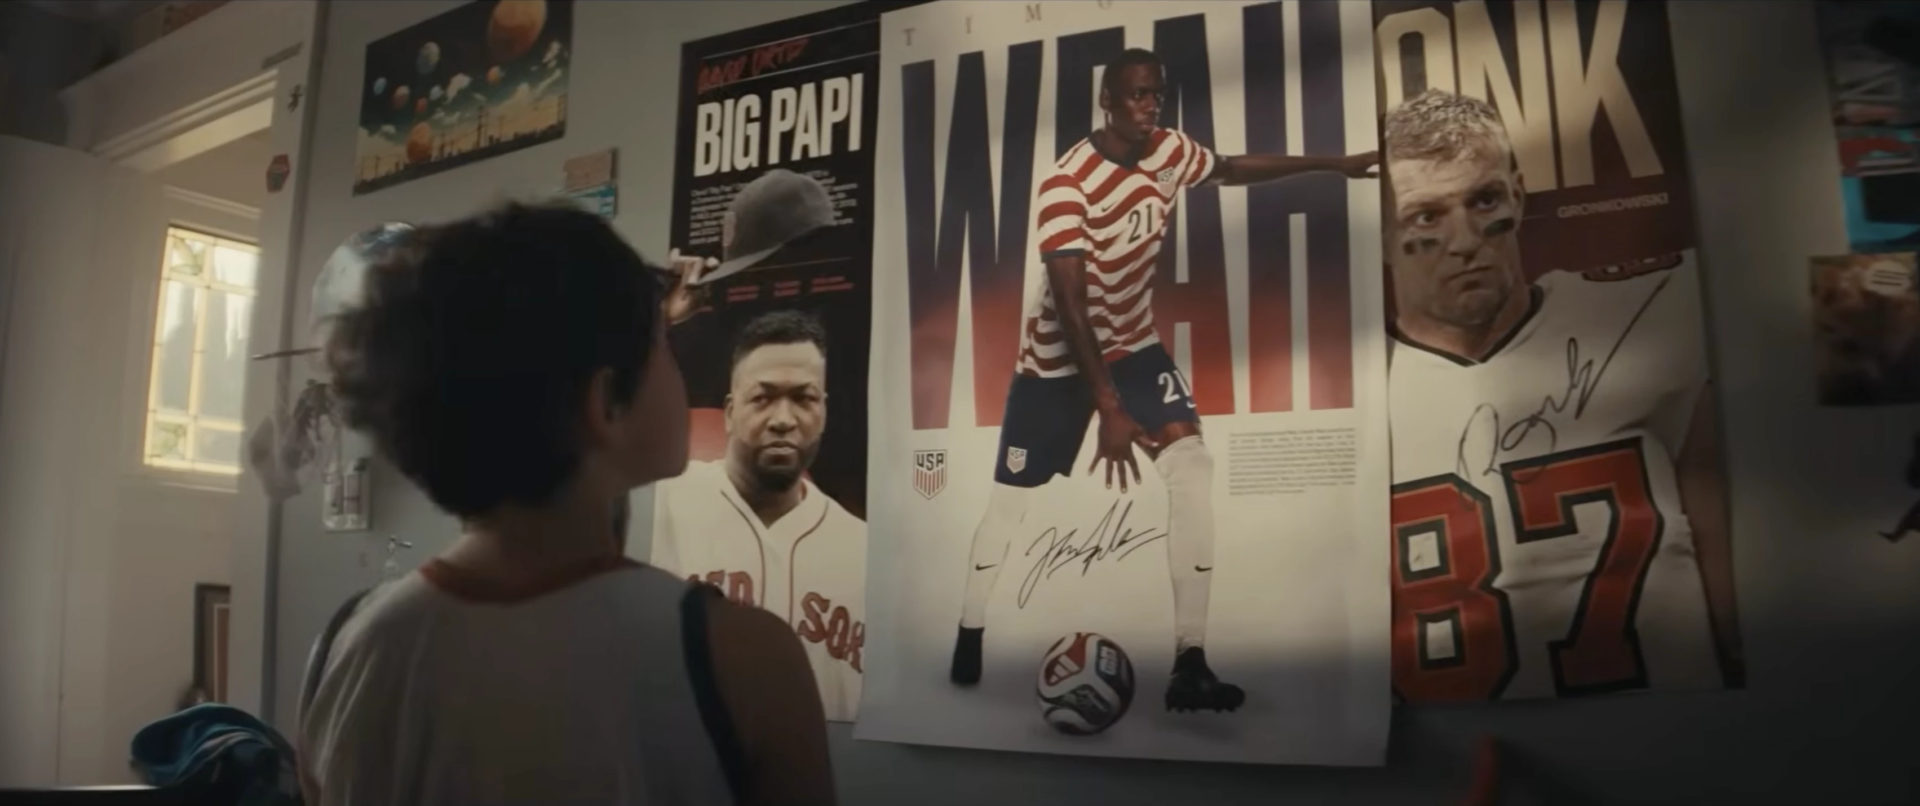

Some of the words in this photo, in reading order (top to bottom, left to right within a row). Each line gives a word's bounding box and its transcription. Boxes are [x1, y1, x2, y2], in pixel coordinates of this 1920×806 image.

[693, 94, 761, 177] BIG
[768, 73, 863, 165] PAPI
[1557, 191, 1669, 218] GRONKOWSKI
[1128, 203, 1153, 245] 21
[1158, 369, 1191, 404] 21
[916, 452, 945, 472] USA
[1390, 434, 1666, 702] 87
